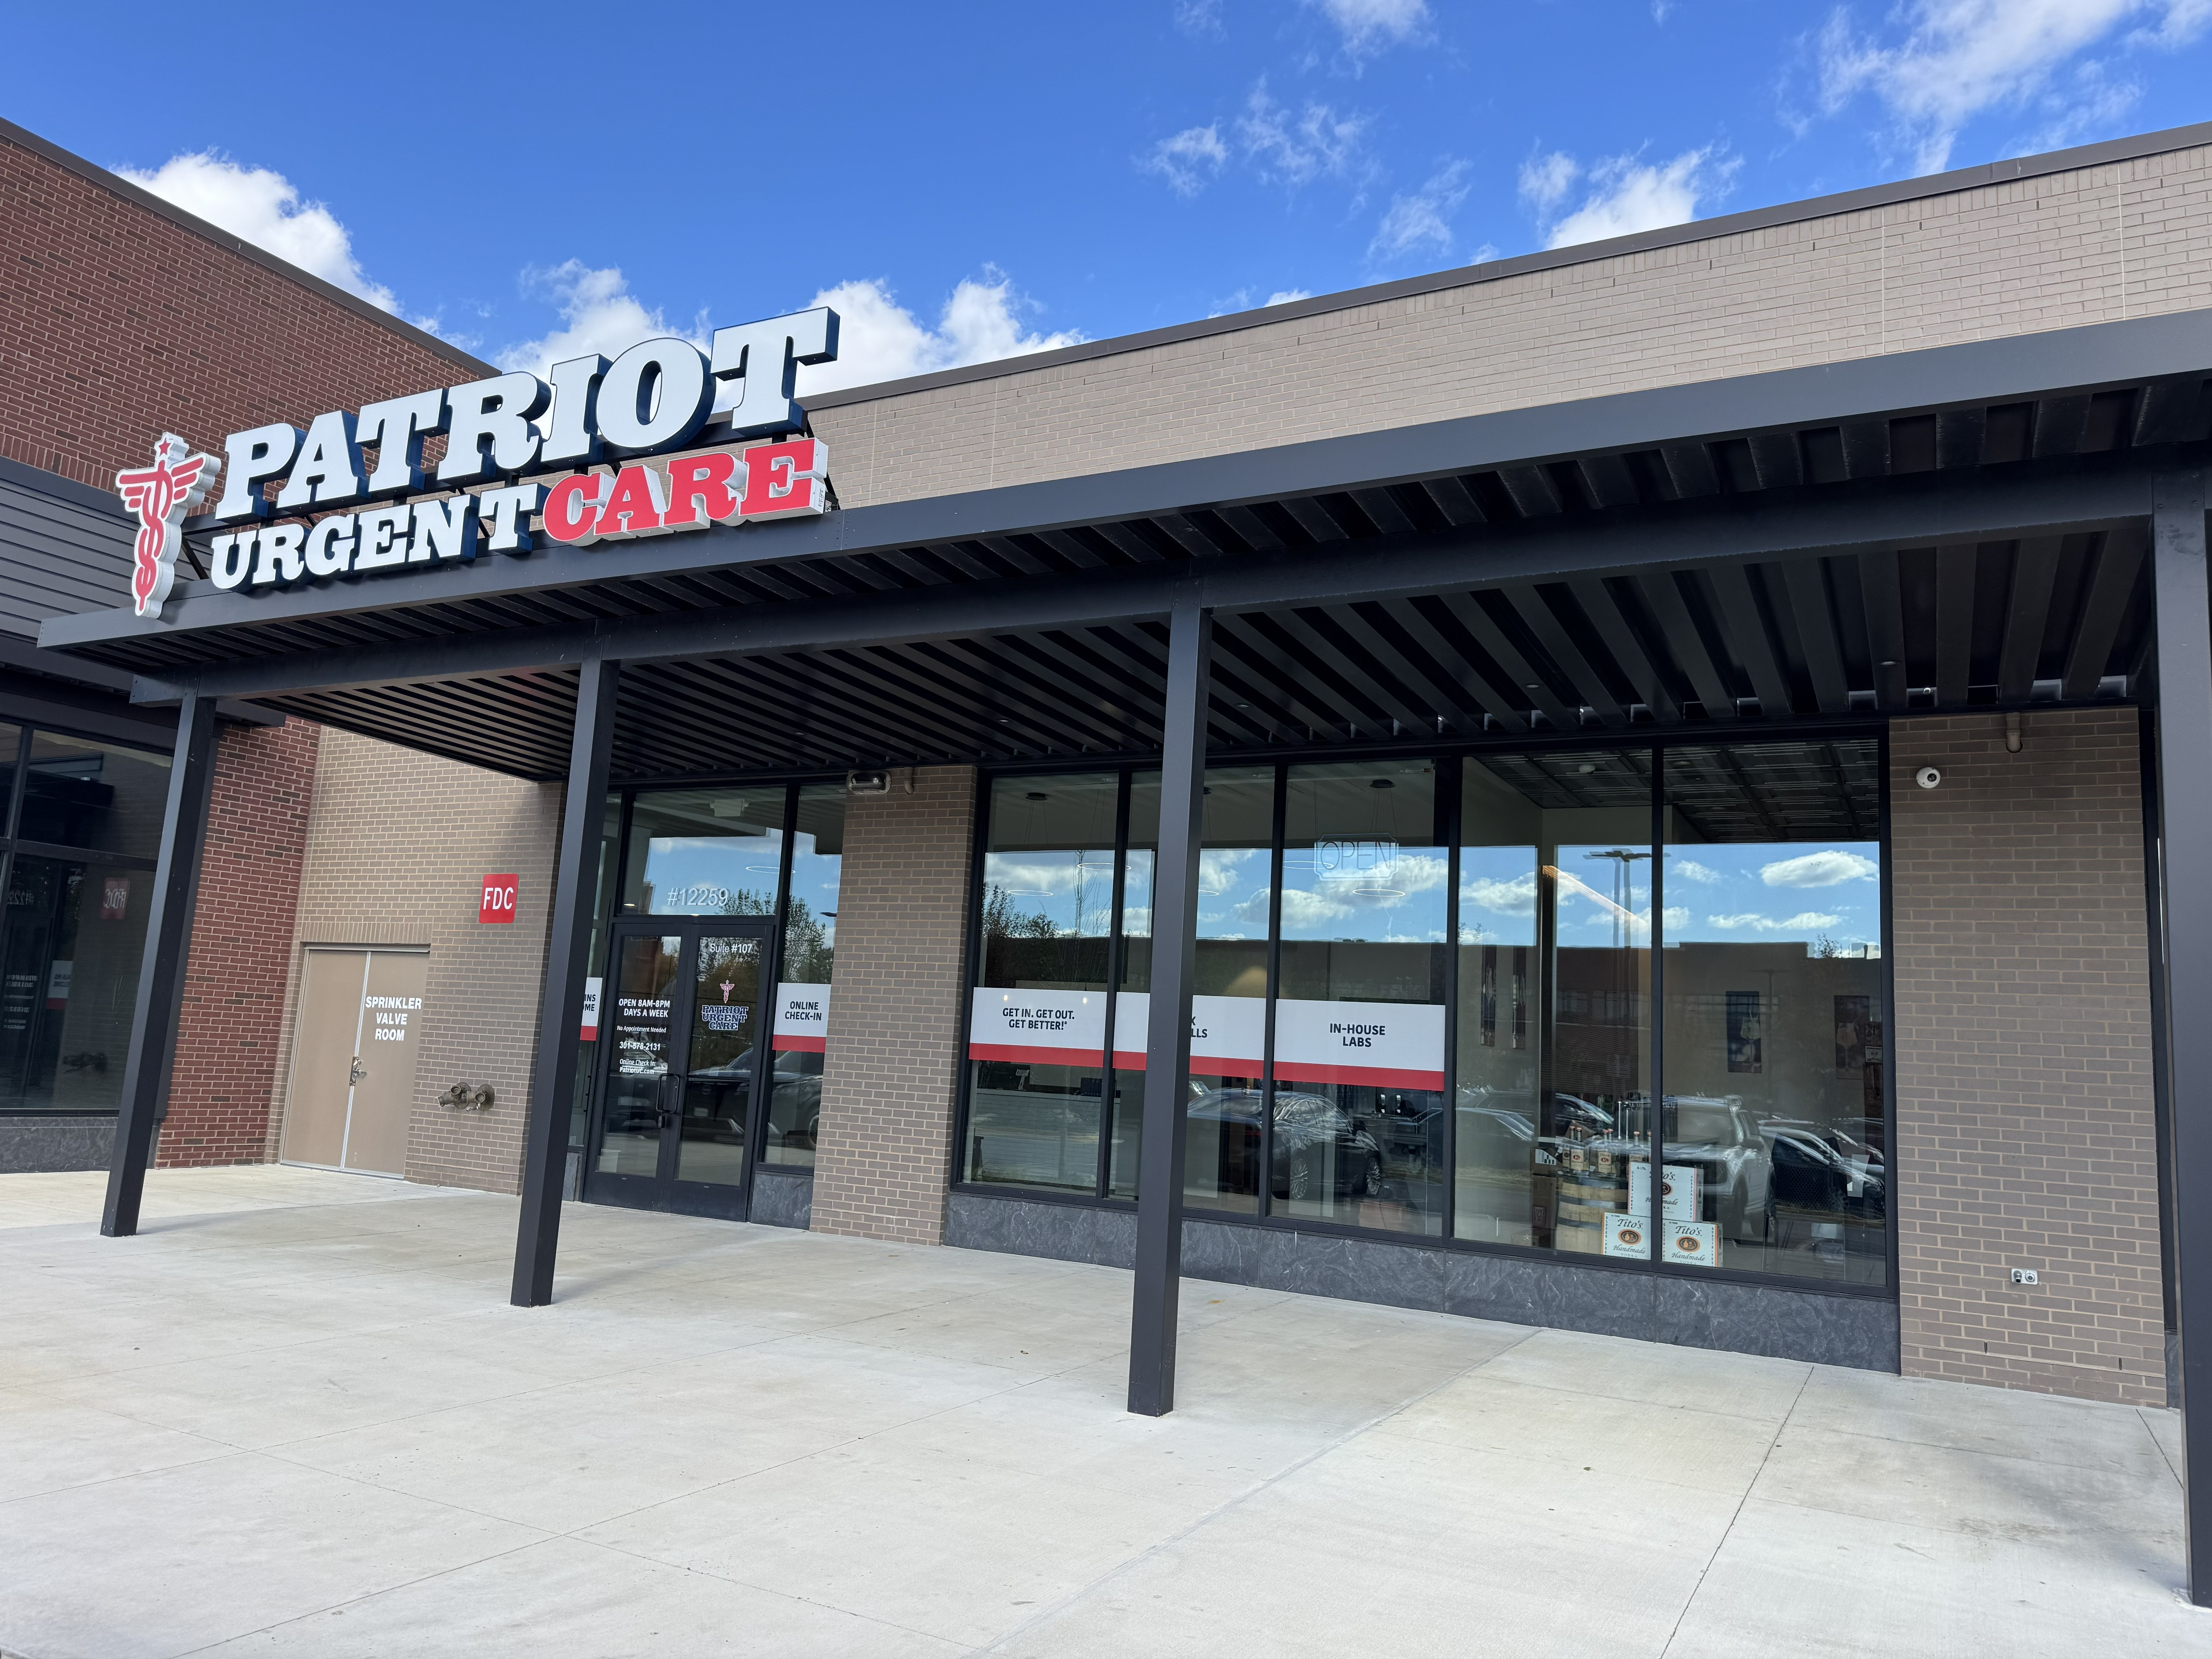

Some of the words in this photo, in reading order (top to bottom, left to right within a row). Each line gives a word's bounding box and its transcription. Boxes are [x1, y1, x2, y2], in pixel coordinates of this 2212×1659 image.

[215, 307, 836, 524] PATRIOT
[210, 483, 547, 592] URGENT
[542, 437, 827, 547] CARE
[1320, 840, 1391, 871] OPEN
[483, 886, 514, 910] FDC
[667, 887, 729, 906] #12259
[709, 943, 730, 953] Suite
[731, 943, 752, 953] #107
[365, 996, 422, 1010] SPRINKLER
[619, 999, 636, 1007] OPEN
[638, 999, 670, 1008] 8AM-8PM
[790, 1001, 819, 1011] ONLINE
[624, 1008, 641, 1017] DAYS
[702, 1005, 749, 1015] PATRIOT
[785, 1010, 822, 1021] CHECK-IN
[1002, 1008, 1020, 1017] GET
[1021, 1008, 1034, 1018] IN.
[1036, 1009, 1053, 1018] GET
[1055, 1010, 1075, 1020] OUT.
[375, 1013, 408, 1025] VALVE
[702, 1013, 747, 1023] URGENT
[709, 1021, 738, 1030] CARE
[1008, 1019, 1026, 1029] GET
[1329, 1023, 1386, 1036] IN-HOUSE
[374, 1029, 405, 1041] ROOM
[1191, 1028, 1207, 1038] LLS
[1342, 1036, 1372, 1047] LABS
[1613, 1244, 1646, 1254] Handmade
[1671, 1251, 1705, 1261] Handmade
